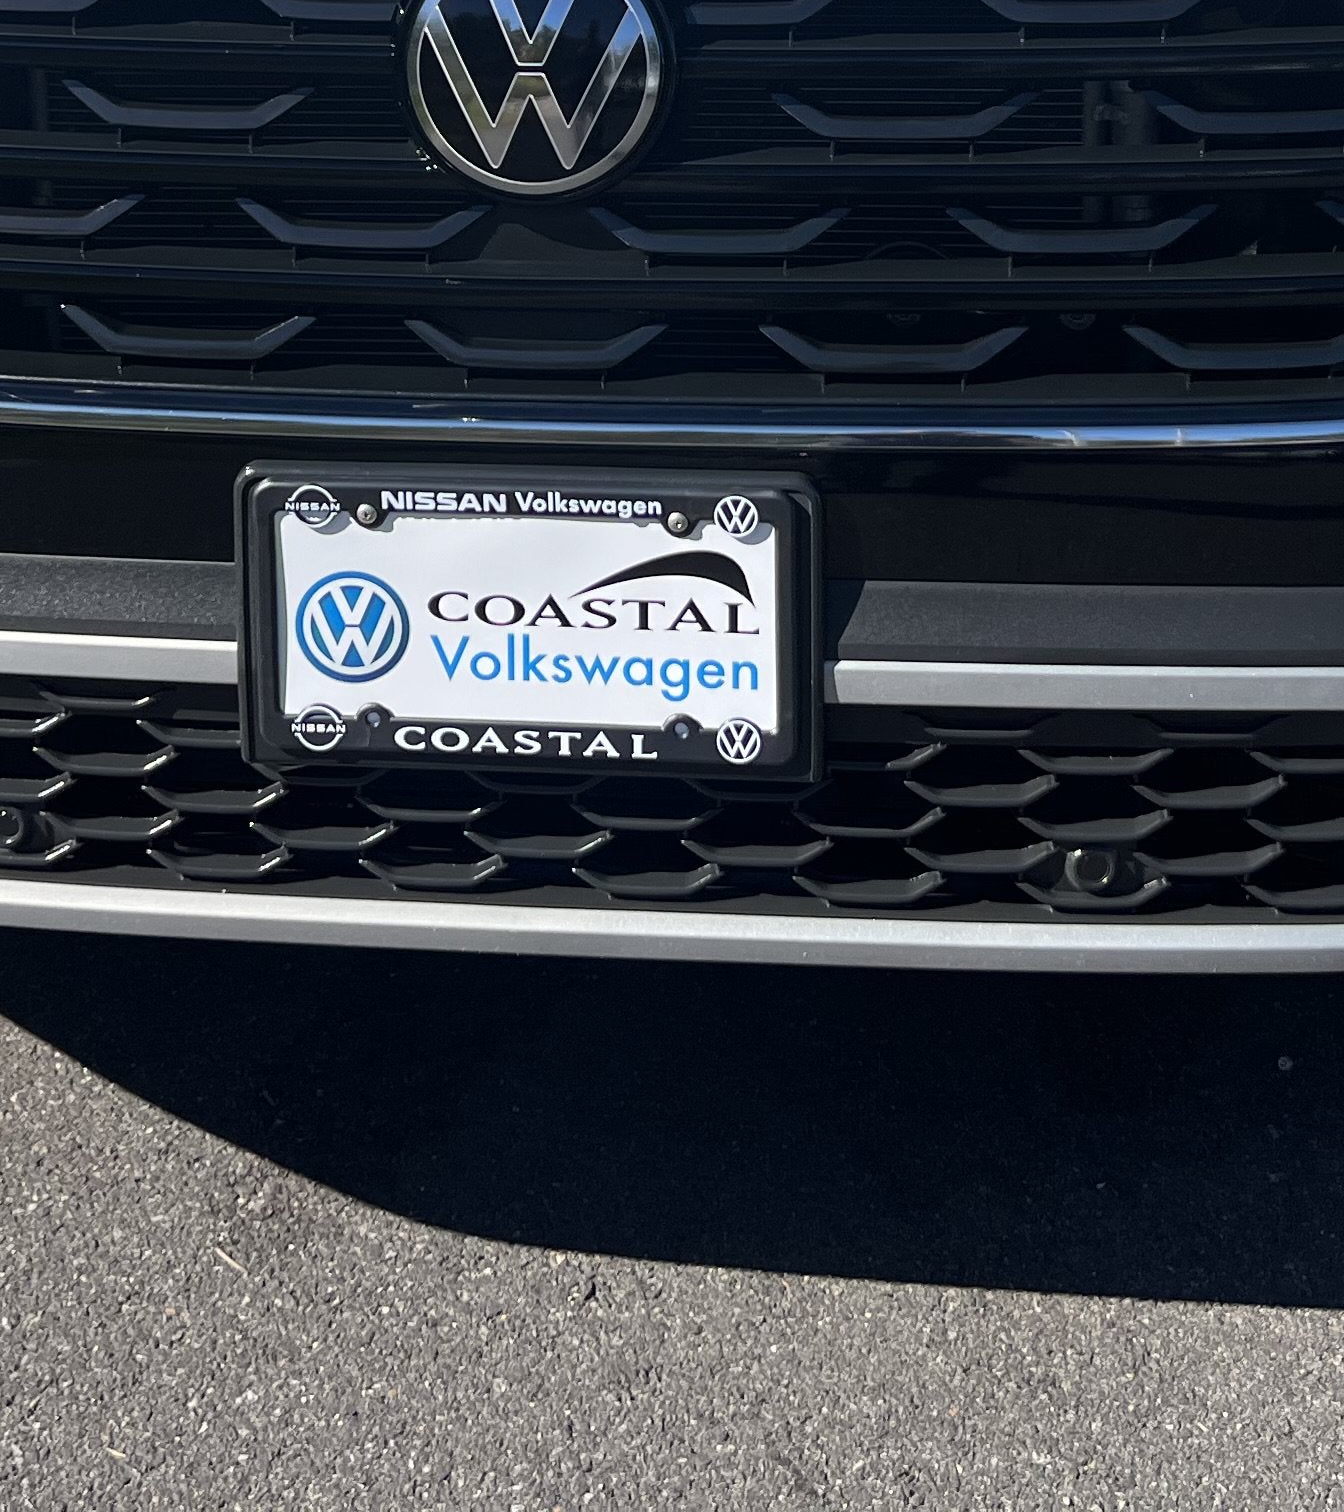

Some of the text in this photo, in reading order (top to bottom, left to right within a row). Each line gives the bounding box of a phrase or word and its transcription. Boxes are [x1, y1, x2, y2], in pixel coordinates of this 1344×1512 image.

[285, 501, 340, 512] NISSAN
[381, 490, 662, 518] NISSAN Volkswagen
[427, 592, 760, 635] COASTAL
[430, 634, 759, 702] Volkswagen
[291, 723, 346, 734] NISSAN
[394, 725, 658, 760] COASTAL
